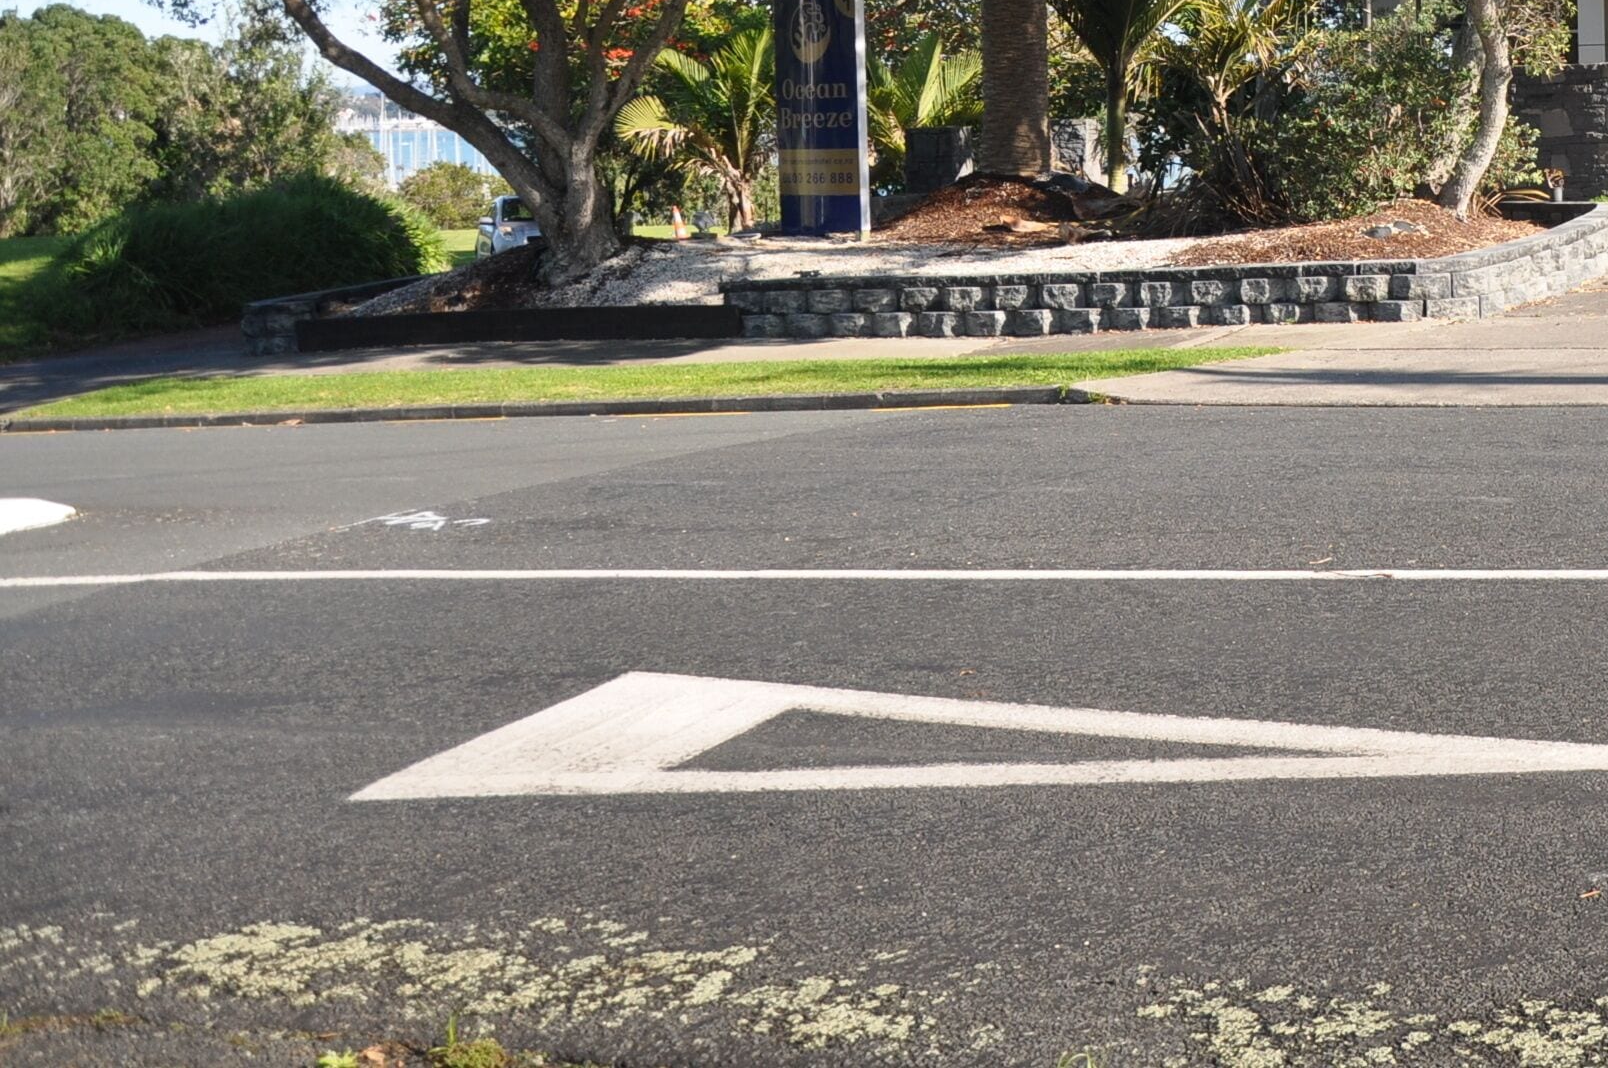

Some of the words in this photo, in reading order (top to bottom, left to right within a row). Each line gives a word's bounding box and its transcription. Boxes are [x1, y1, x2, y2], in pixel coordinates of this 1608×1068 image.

[781, 78, 849, 100] Ocean
[780, 108, 854, 129] Breeze
[806, 172, 826, 184] 266
[830, 172, 854, 184] 888
